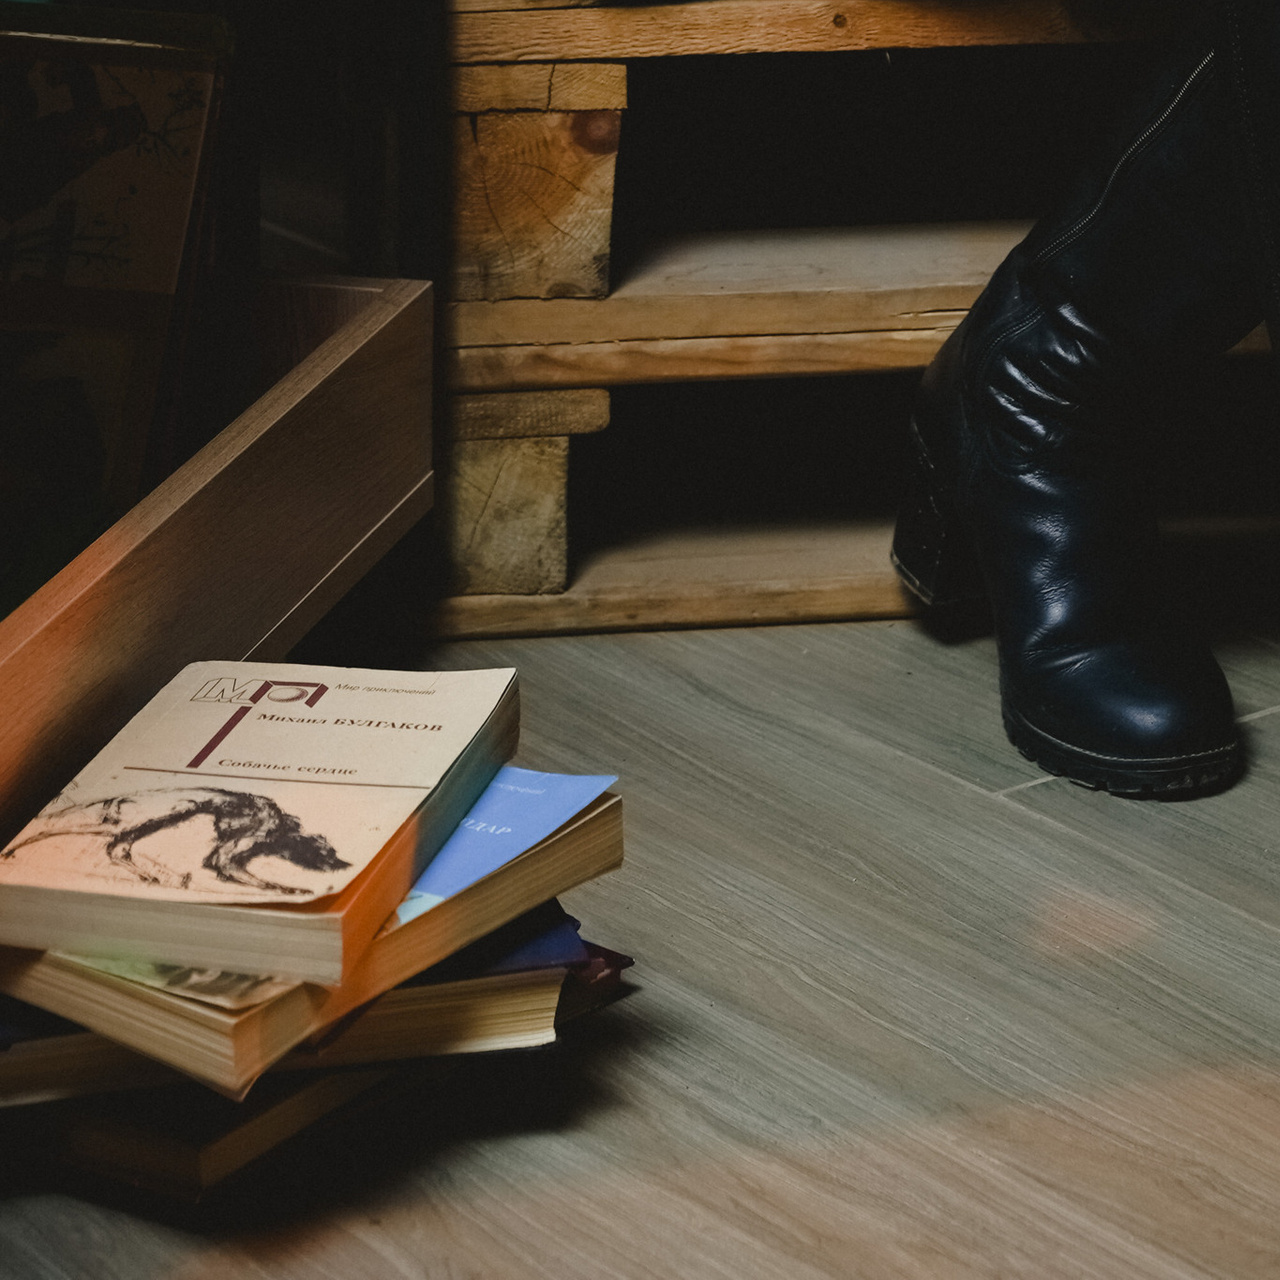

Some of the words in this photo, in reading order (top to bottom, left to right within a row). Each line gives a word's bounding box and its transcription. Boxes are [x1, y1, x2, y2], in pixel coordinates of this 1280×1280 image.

[335, 683, 360, 691] Мир
[362, 686, 436, 696] приключений
[257, 713, 327, 725] Михаил
[334, 718, 443, 732] БУЛГАКОВ
[218, 758, 291, 772] Собачье
[297, 766, 358, 776] сердце
